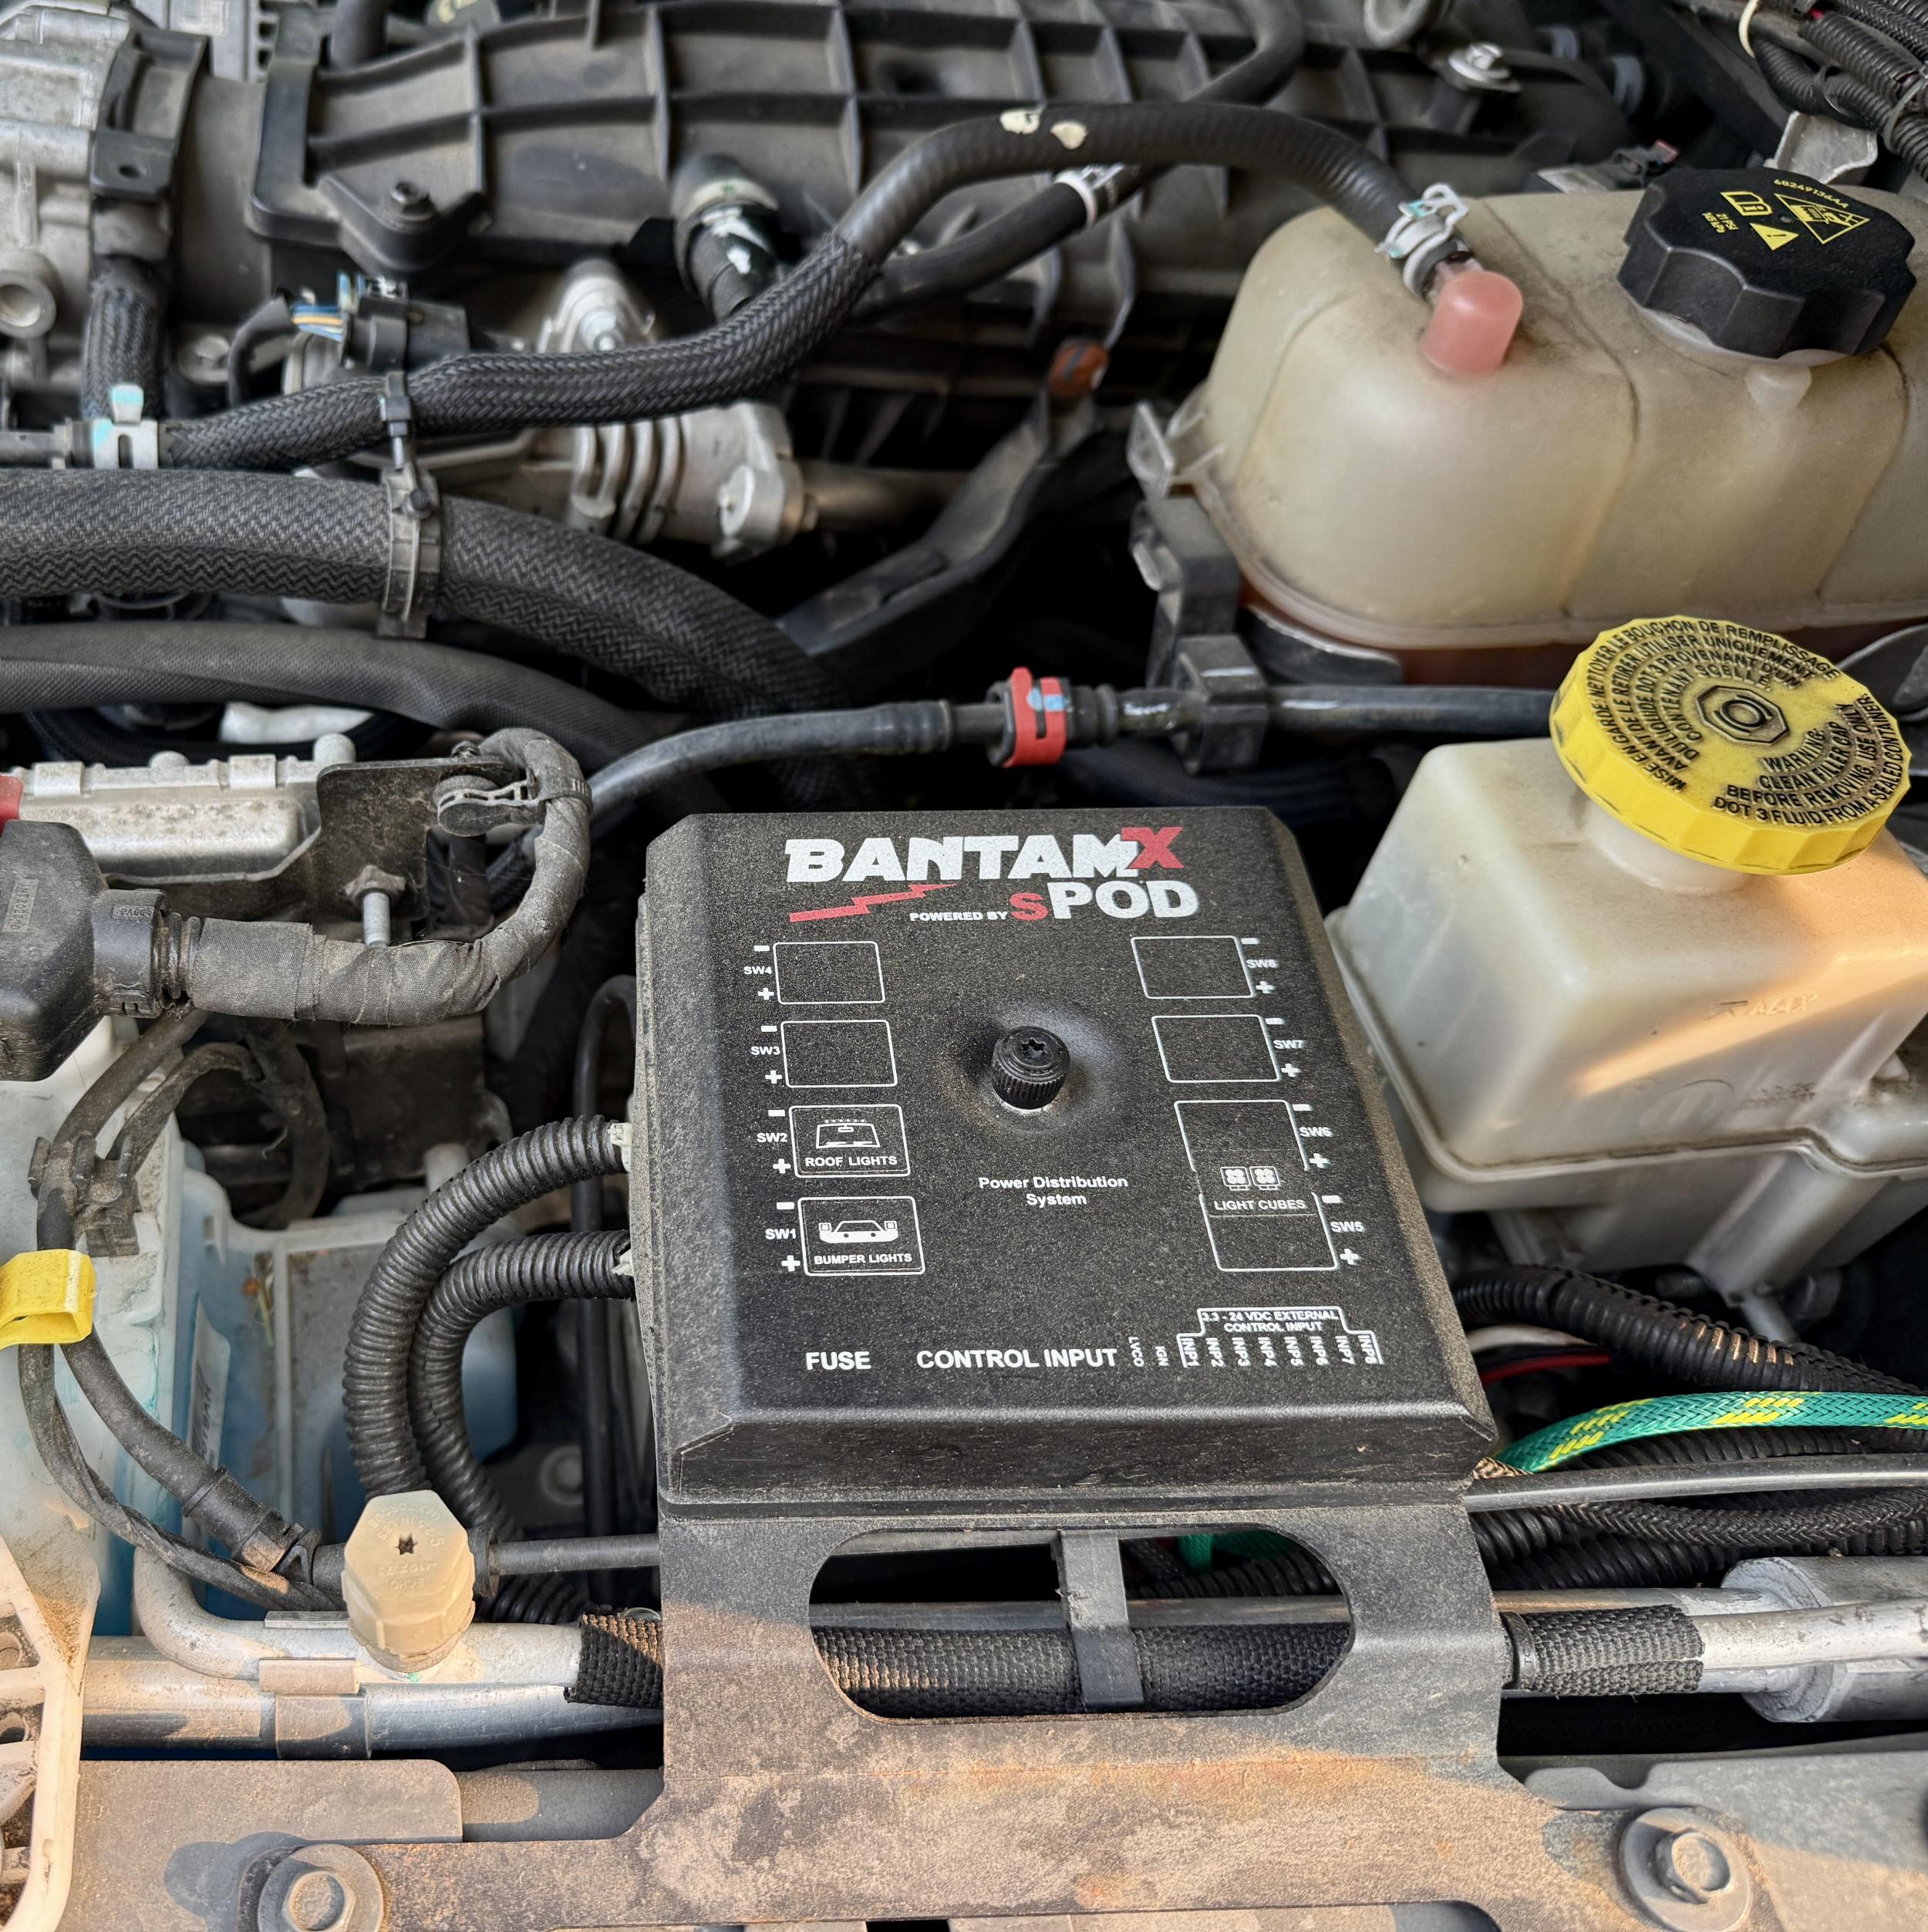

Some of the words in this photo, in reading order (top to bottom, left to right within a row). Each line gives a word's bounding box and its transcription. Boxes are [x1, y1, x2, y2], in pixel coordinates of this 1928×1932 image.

[1621, 619, 1694, 642] BOUCHON
[1698, 620, 1721, 634] DE
[1610, 634, 1630, 650] LE
[1633, 634, 1700, 657] UTILISER
[1725, 624, 1841, 681] REMPLISSAGE
[1657, 649, 1758, 674] PROVENANT
[1703, 636, 1815, 681] UNIQUEMENT
[1586, 645, 1617, 698] NETTOYER
[1635, 669, 1659, 693] DOT
[1613, 697, 1633, 714] LE
[1658, 666, 1703, 742] CONTENANT
[1620, 716, 1646, 732] DE
[1634, 695, 1678, 743] LIQUIDE
[1834, 703, 1872, 734] ONLY
[1826, 721, 1852, 748] CAP
[1621, 744, 1650, 763] EN
[1633, 734, 1689, 772] AVANT
[1670, 741, 1700, 761] DU
[1855, 736, 1878, 762] USE
[1643, 761, 1687, 791] MISE
[1812, 746, 1851, 784] FILLER
[1757, 774, 1818, 792] CLEAN
[1868, 760, 1904, 803] SEALED
[1713, 796, 1751, 819] DOT
[1726, 784, 1804, 810] BEFORE
[1860, 795, 1881, 812] A
[1754, 808, 1770, 823] 3
[1771, 810, 1823, 826] FLUID
[1822, 797, 1869, 825] FROM
[909, 912, 984, 922] POWERED
[985, 910, 1009, 922] BY
[743, 966, 773, 975] SW4
[1245, 959, 1279, 969] SW8
[750, 1046, 781, 1056] SW3
[1272, 1040, 1305, 1050] SW7
[757, 1132, 788, 1143] SW2
[1299, 1126, 1333, 1138] SW6
[804, 1157, 844, 1167] ROOF
[848, 1155, 898, 1166] LIGHTS
[978, 1177, 1030, 1189] Power
[1033, 1175, 1129, 1189] Distribution
[1026, 1193, 1087, 1209] System
[1213, 1199, 1256, 1210] LIGHT
[1258, 1199, 1308, 1209] CUBES
[765, 1228, 797, 1240] SW1
[1330, 1221, 1366, 1232] SW5
[814, 1254, 866, 1265] BUMPER
[868, 1253, 913, 1263] LIGHTS
[1201, 1312, 1221, 1322] 3.3
[1229, 1312, 1244, 1321] 24
[1244, 1311, 1272, 1321] VDC
[1273, 1310, 1340, 1321] EXTERNAL
[1223, 1323, 1285, 1333] CONTROL
[1286, 1321, 1324, 1332] INPUT
[916, 1349, 1040, 1369] CONTROL
[1043, 1348, 1118, 1368] INPUT
[1127, 1336, 1145, 1368] LVCO
[1154, 1345, 1169, 1367] IGN
[1181, 1337, 1201, 1367] INP1
[1205, 1337, 1226, 1368] INP2
[1232, 1337, 1252, 1367] INP3
[1257, 1337, 1279, 1367] INP4
[1283, 1336, 1305, 1367] INP5
[1309, 1336, 1331, 1366] INP6
[1334, 1335, 1356, 1366] INP7
[1357, 1334, 1379, 1365] INP8
[805, 1351, 872, 1371] FUSE
